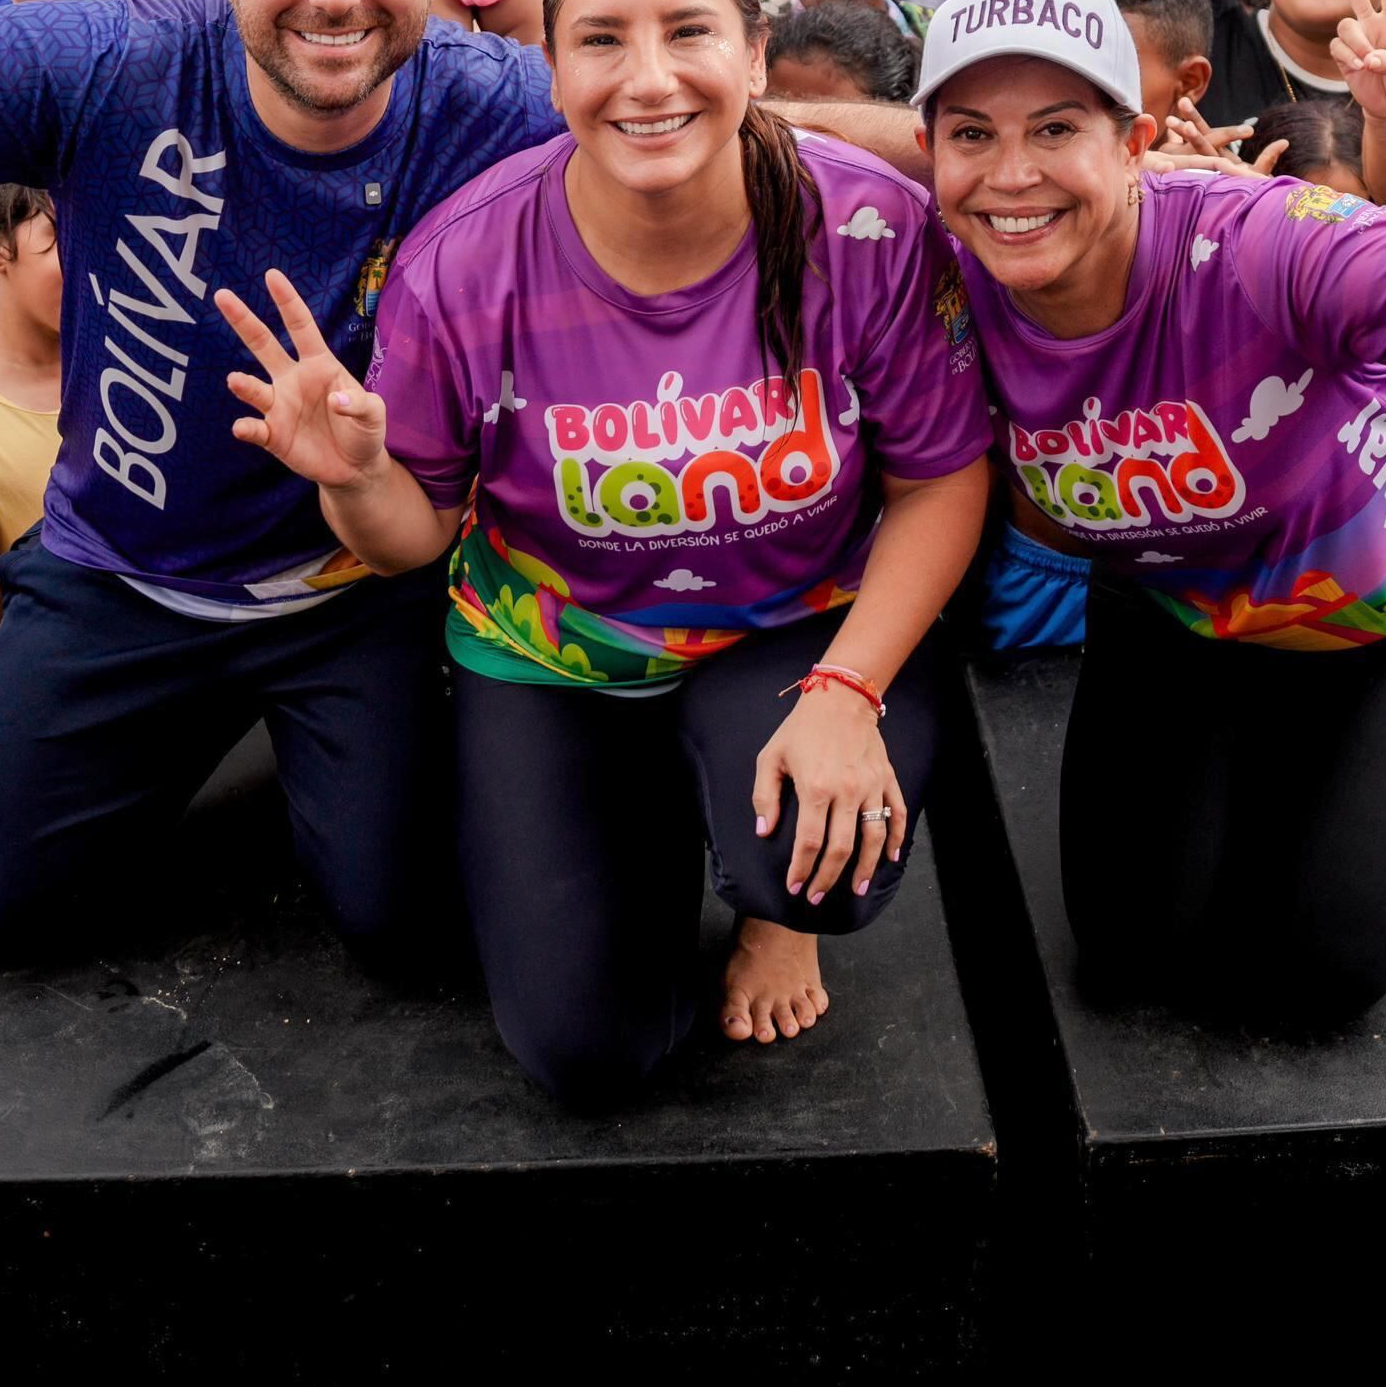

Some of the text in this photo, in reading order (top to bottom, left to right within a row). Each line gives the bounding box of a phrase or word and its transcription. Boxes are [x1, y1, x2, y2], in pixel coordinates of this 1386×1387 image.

[88, 128, 227, 511] BOLÍVAR
[550, 371, 796, 452] BOLÍVAR
[1012, 397, 1189, 462] BOLÍVAR
[578, 538, 622, 552] DONDE
[625, 541, 645, 552] LA
[649, 533, 720, 551] DIVERSIÓN
[724, 531, 740, 543] SE
[744, 516, 789, 540] QUEDÓ
[792, 513, 805, 525] A
[1088, 532, 1107, 542] LA
[1109, 527, 1164, 542] DIVERSIÓN
[1168, 527, 1181, 537] SE
[1182, 520, 1221, 535] QUEDÓ
[1223, 520, 1235, 530] A
[1236, 505, 1269, 526] VIVIR
